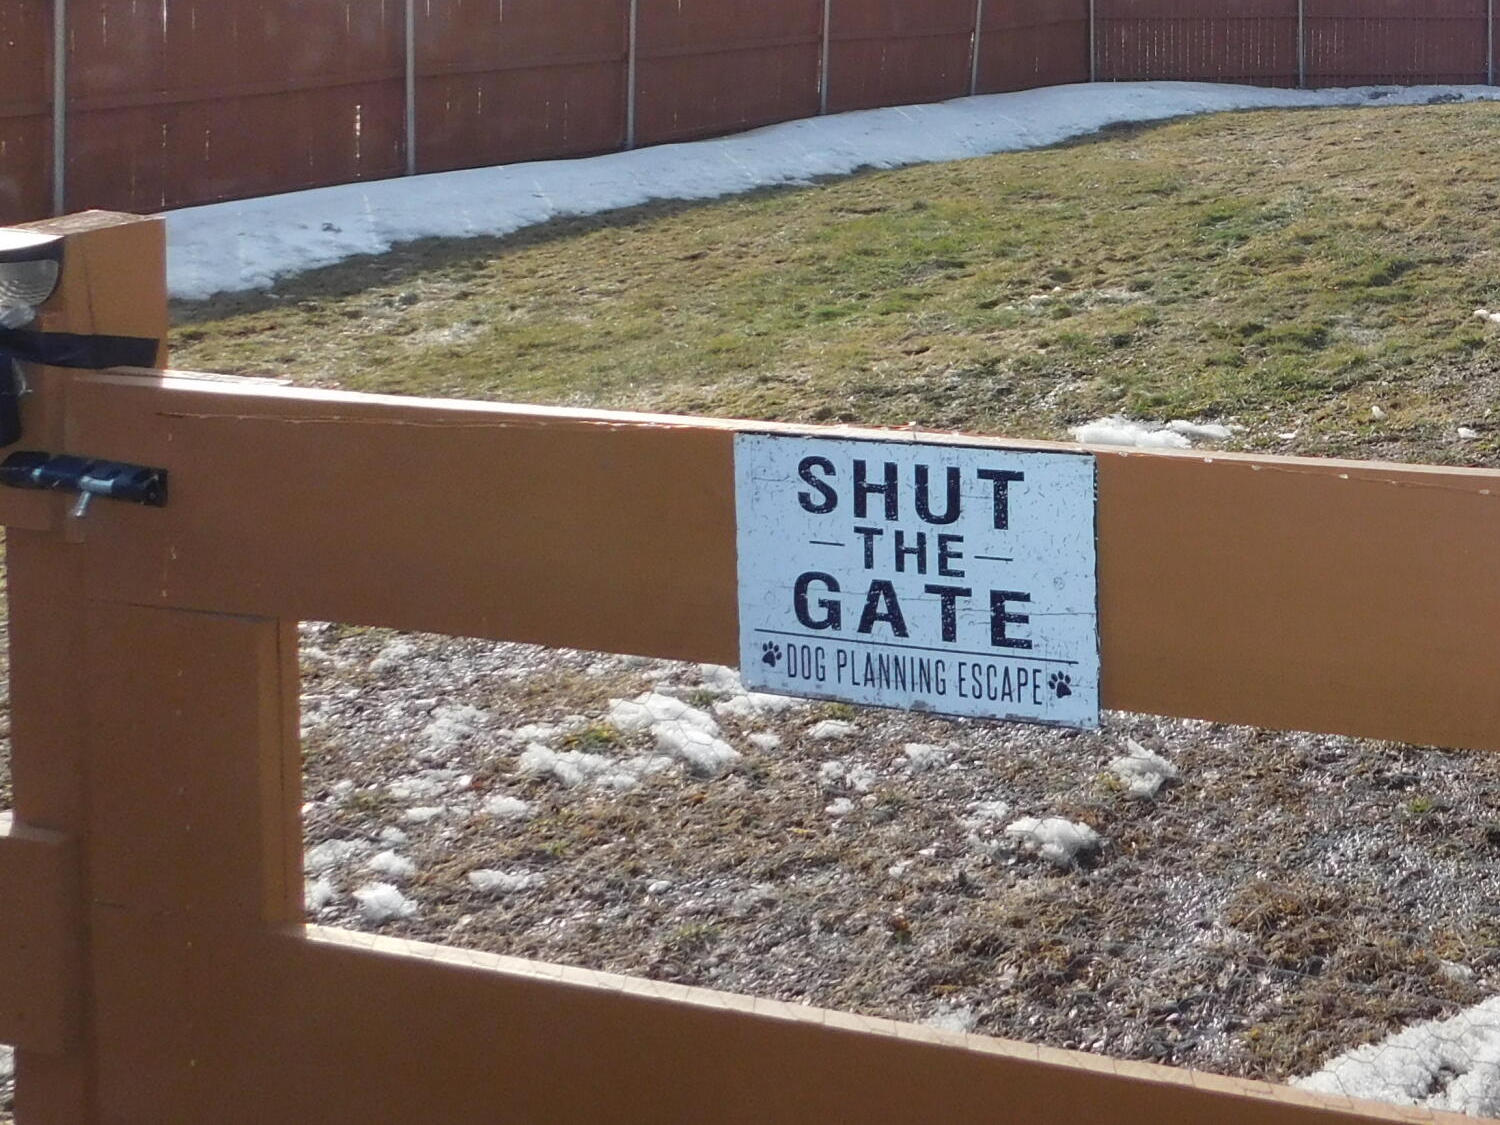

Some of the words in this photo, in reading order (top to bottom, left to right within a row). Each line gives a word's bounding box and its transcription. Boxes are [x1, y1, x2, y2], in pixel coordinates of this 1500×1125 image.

[797, 455, 1024, 530] SHUT
[853, 526, 965, 577] THE
[793, 571, 1033, 650] GATE
[787, 642, 826, 682] DOG
[836, 649, 946, 695] PLANNING
[958, 661, 1043, 705] ESCAPE
